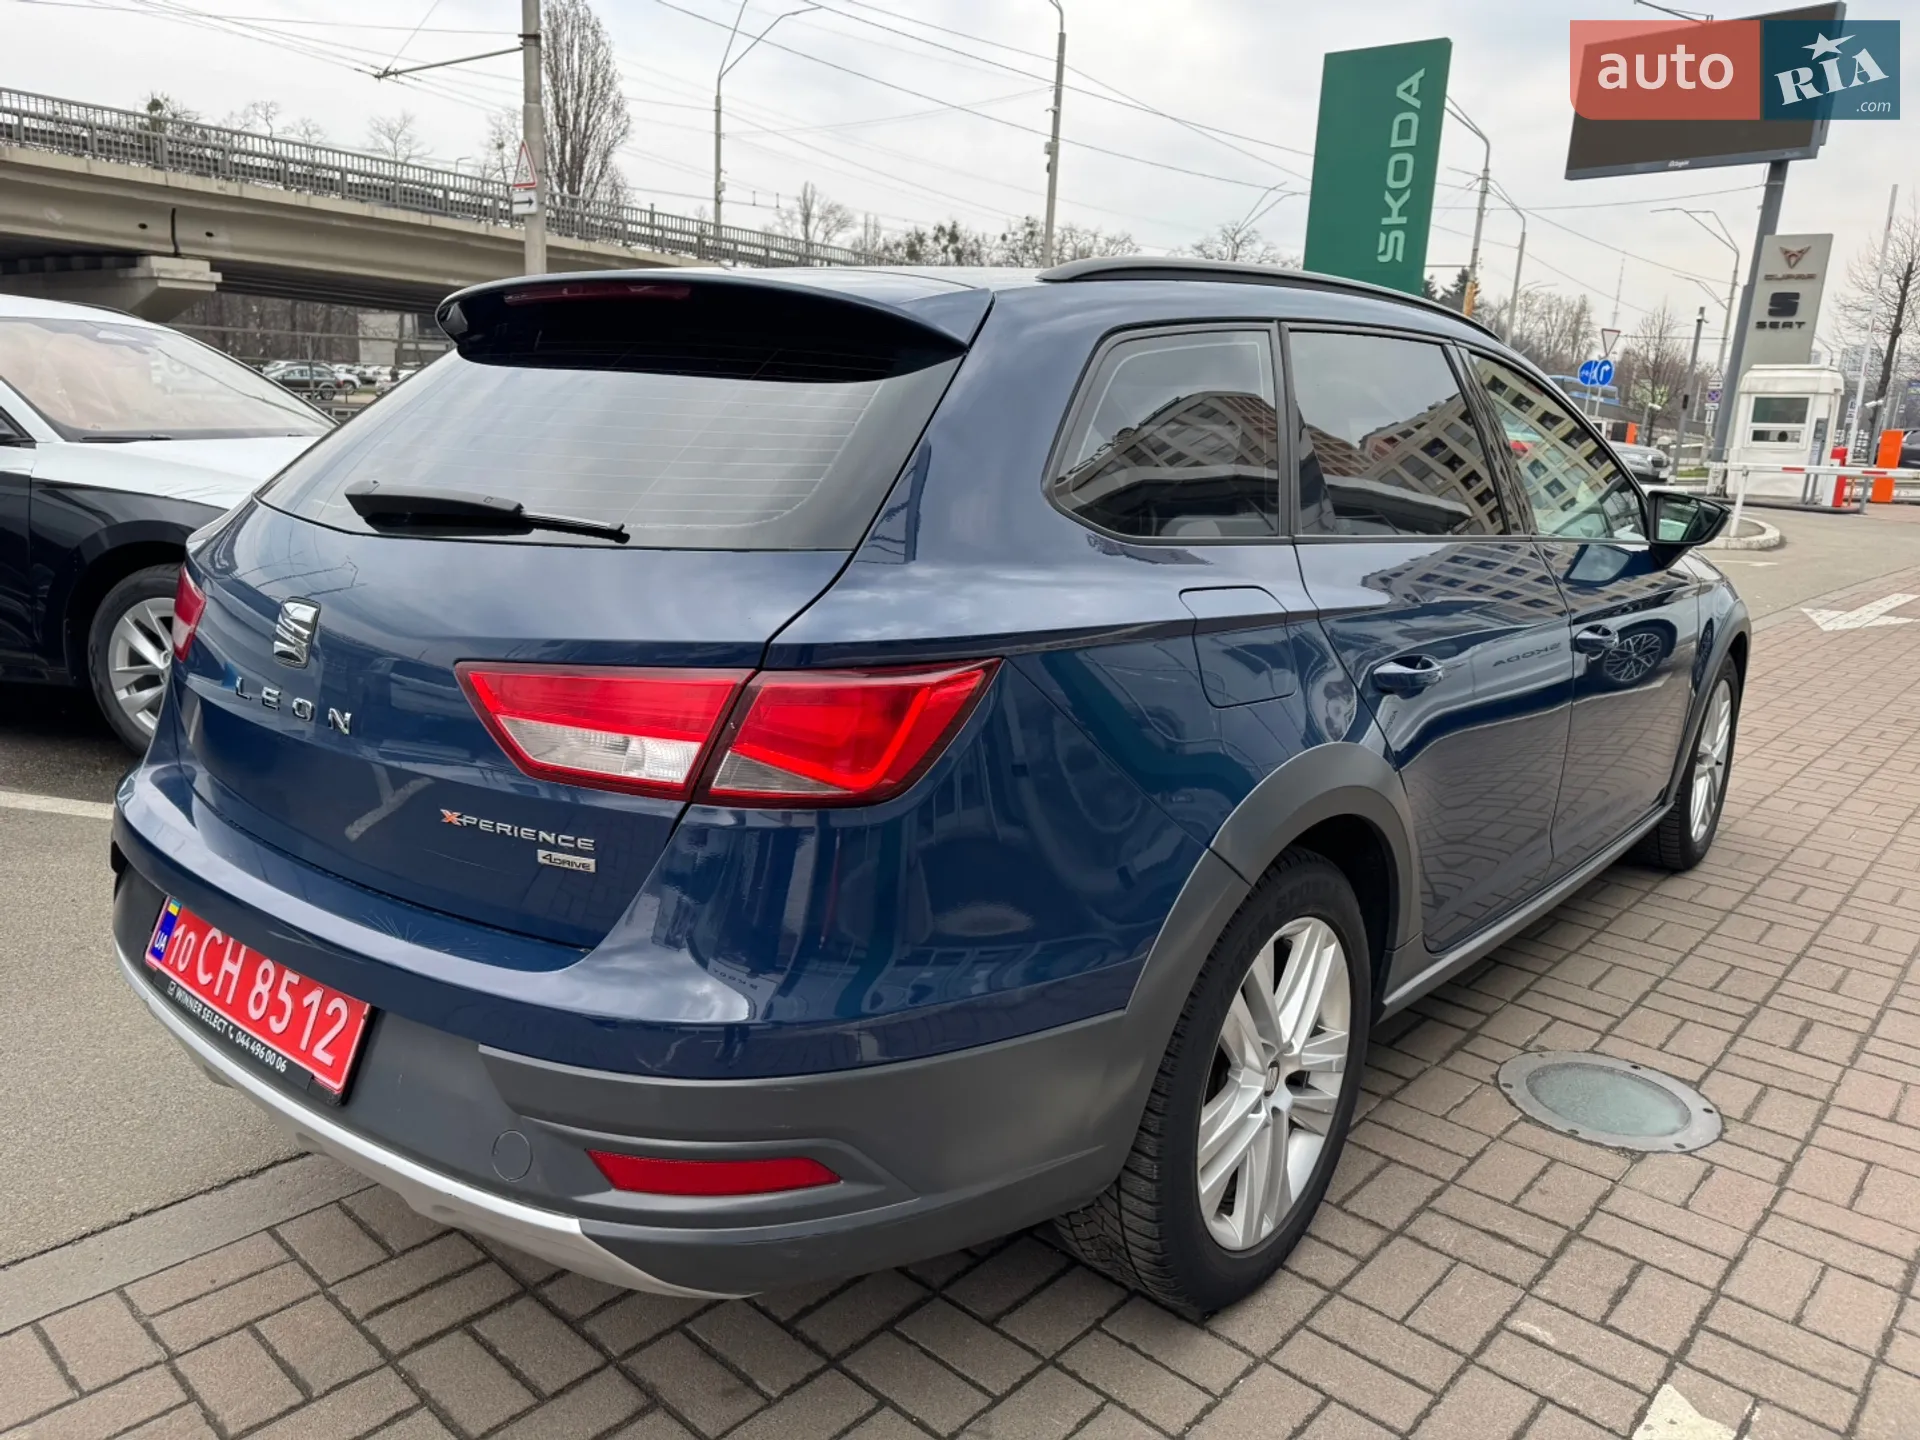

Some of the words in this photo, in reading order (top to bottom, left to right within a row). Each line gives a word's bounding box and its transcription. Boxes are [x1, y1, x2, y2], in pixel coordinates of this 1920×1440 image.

[1755, 321, 1806, 330] SEAT
[235, 676, 352, 735] LEON
[440, 808, 595, 851] XPERIENCE
[542, 853, 591, 871] 4DRIVE
[154, 930, 168, 954] UA
[169, 923, 196, 972] 10
[197, 927, 248, 1005] CH
[248, 958, 349, 1067] 8512
[175, 984, 203, 1017] WINNER
[201, 1007, 228, 1034] SELECT
[235, 1030, 251, 1050] 044
[250, 1040, 266, 1060] 496
[265, 1050, 276, 1066] 00
[275, 1056, 287, 1073] 06
